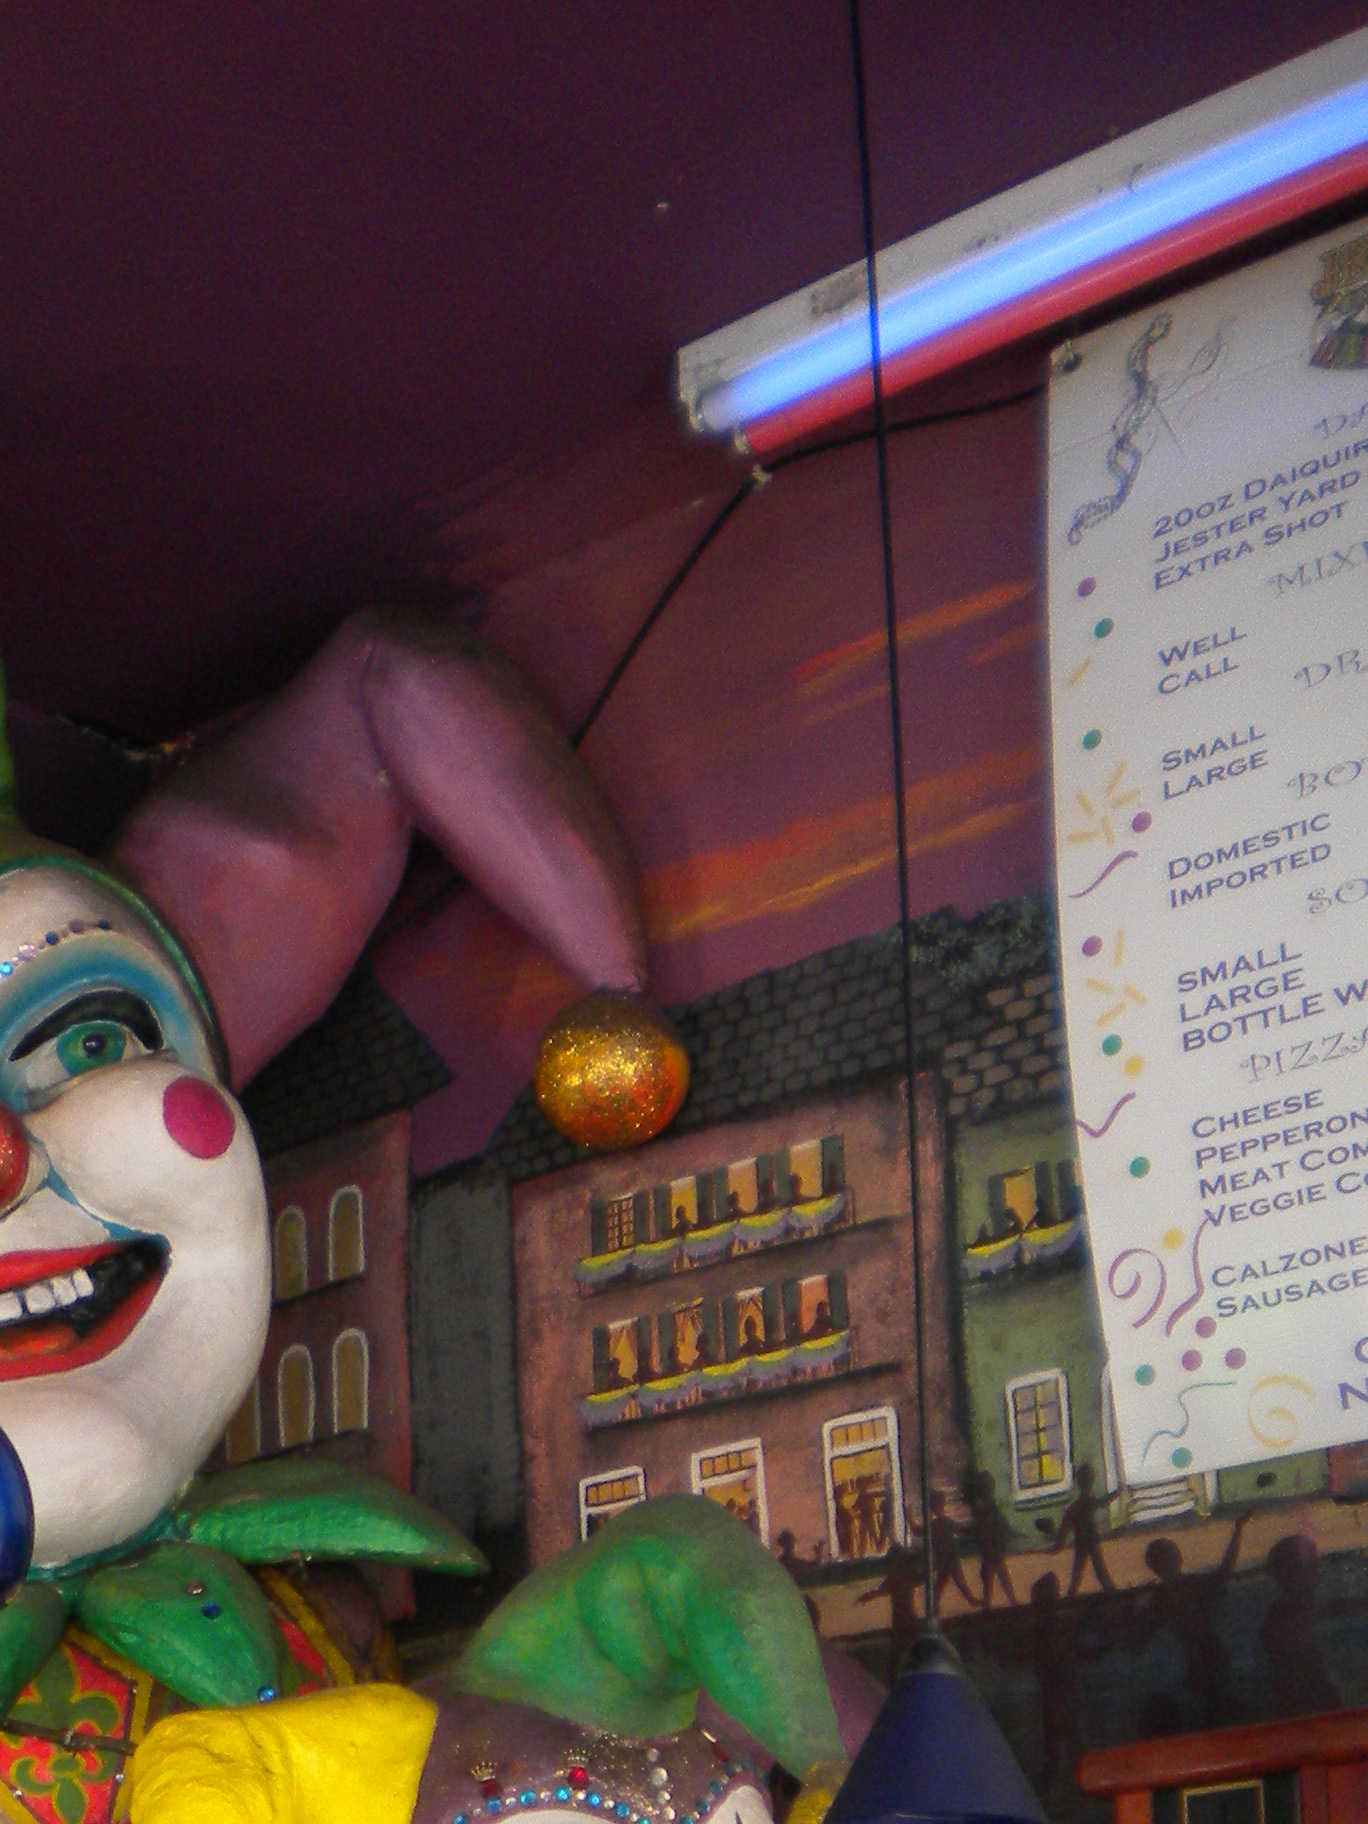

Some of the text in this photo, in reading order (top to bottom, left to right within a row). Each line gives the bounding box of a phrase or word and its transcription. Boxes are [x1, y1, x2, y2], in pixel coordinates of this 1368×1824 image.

[1155, 470, 1360, 563] JESTER YARD
[1153, 500, 1350, 591] EXTRA SHOT
[1157, 626, 1248, 667] WELL
[1157, 657, 1241, 695] CALL
[1161, 726, 1266, 772] SMALL
[1163, 750, 1269, 800] LARGE
[1288, 757, 1368, 796] BO
[1167, 813, 1330, 880] DOMESTIC
[1169, 843, 1331, 909] IMPORTED
[1177, 943, 1303, 993] SMALL
[1179, 968, 1306, 1023] LARGE
[1183, 993, 1325, 1051] BOTTLE
[1191, 1089, 1324, 1138] CHEESE
[1195, 1108, 1368, 1169] PEPPERON
[1199, 1160, 1290, 1198] MEAT
[1204, 1183, 1327, 1227] VEGGIE
[1212, 1236, 1368, 1287] CALZONE
[1216, 1267, 1368, 1317] SAUSAGE
